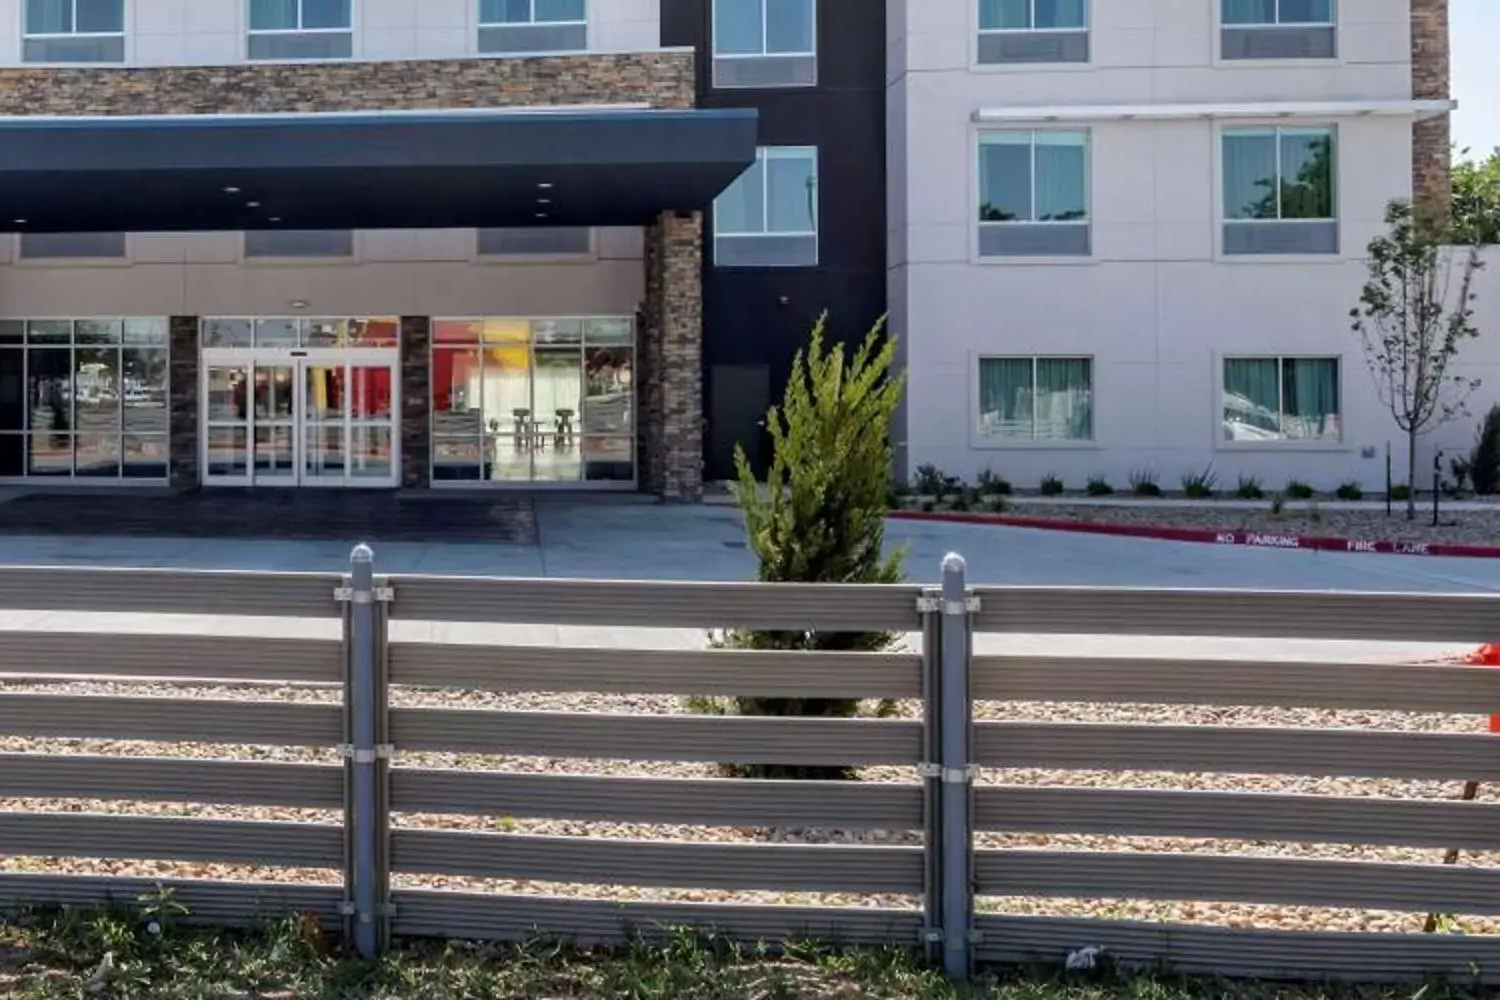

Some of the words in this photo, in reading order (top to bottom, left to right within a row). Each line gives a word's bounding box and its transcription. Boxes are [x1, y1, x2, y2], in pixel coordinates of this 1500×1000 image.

[1216, 532, 1235, 544] NO
[1245, 533, 1299, 547] PARKING
[1392, 541, 1429, 554] LANE
